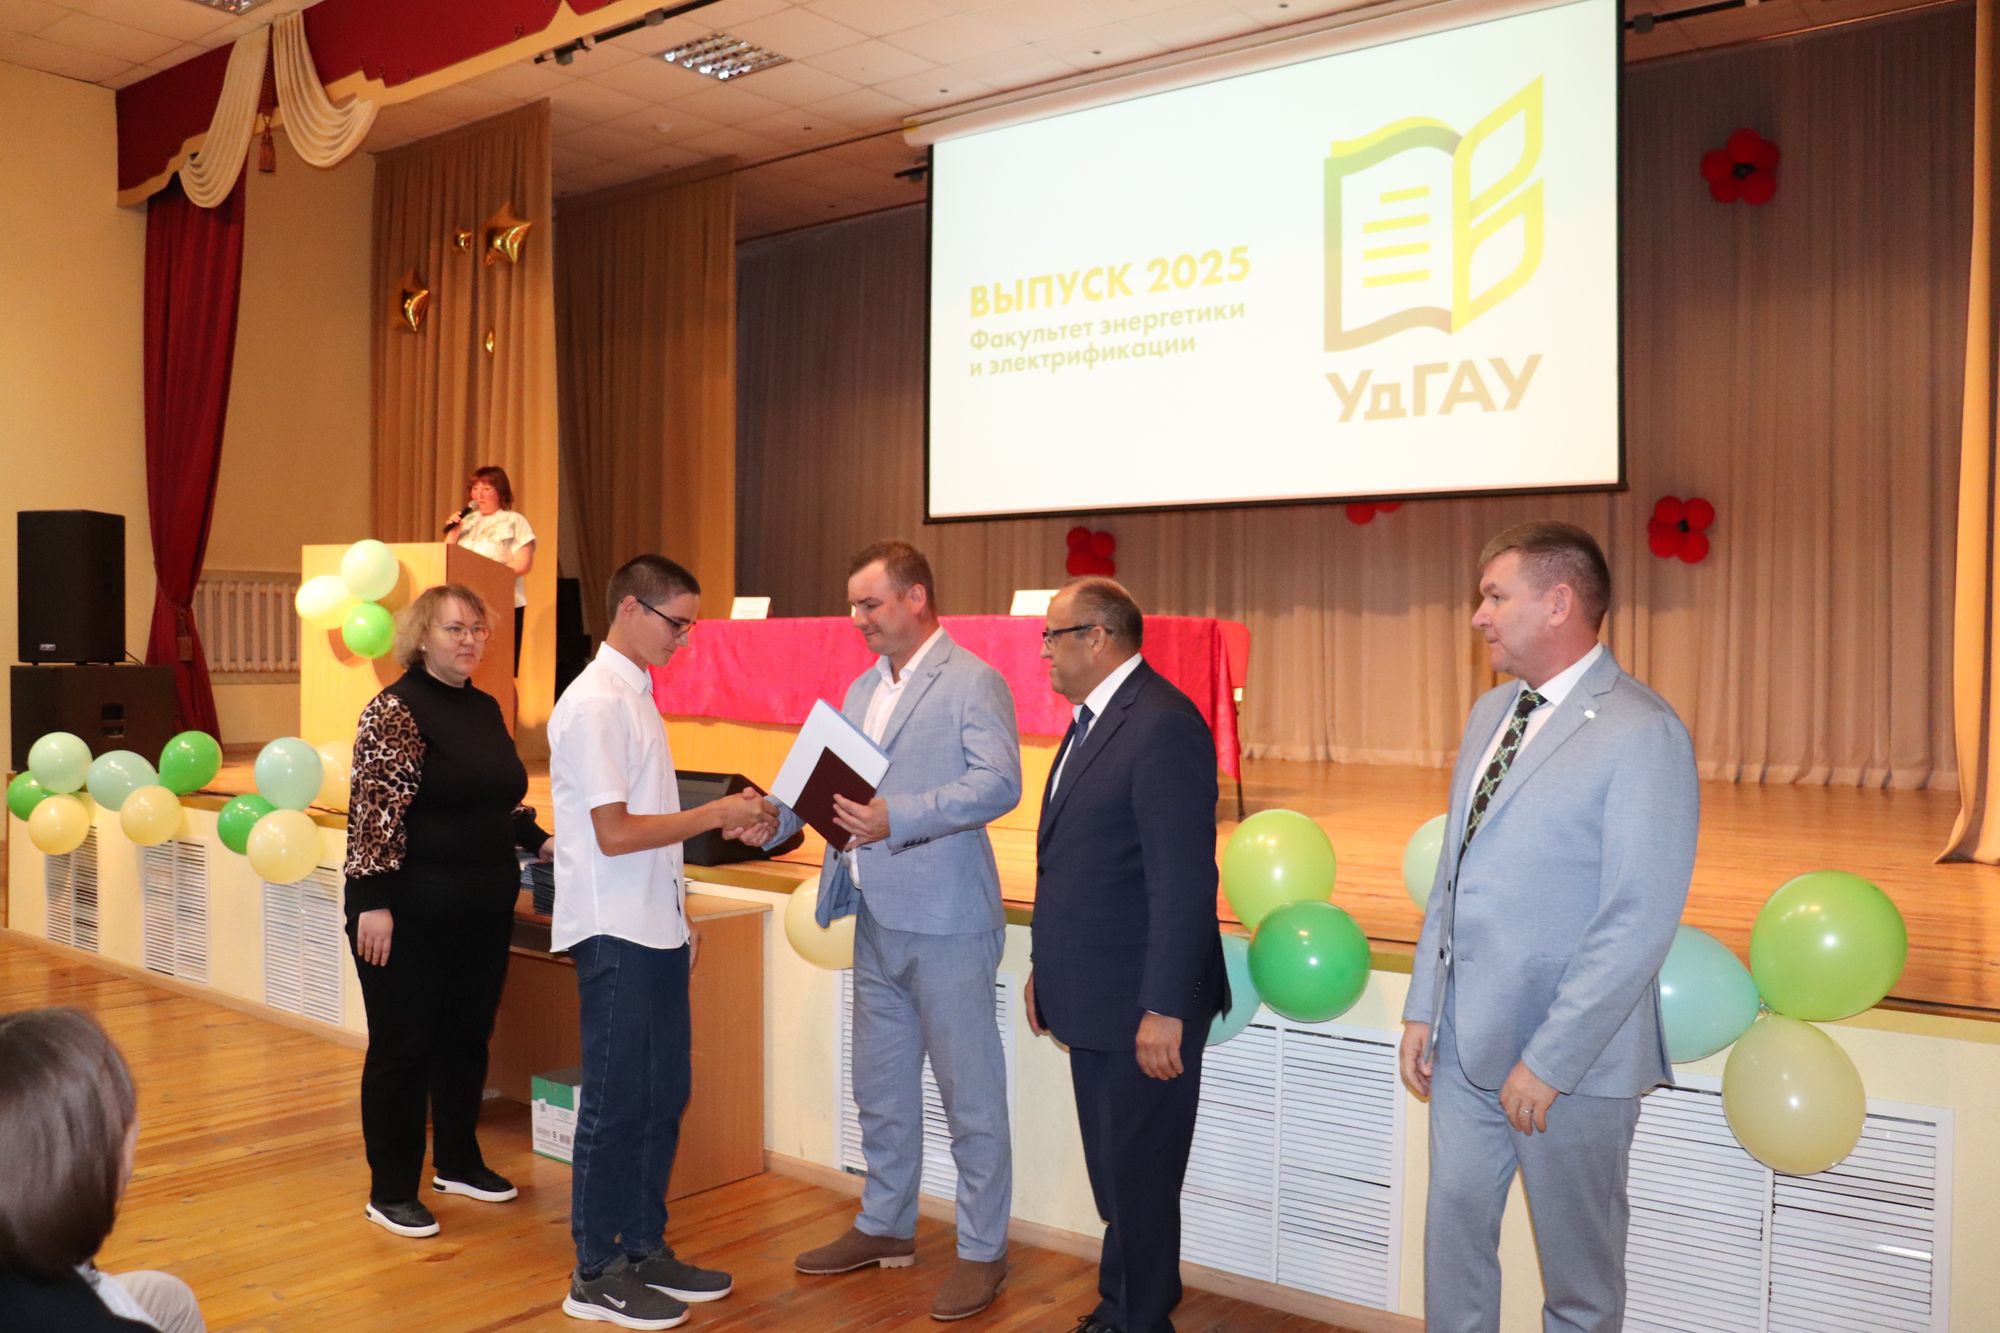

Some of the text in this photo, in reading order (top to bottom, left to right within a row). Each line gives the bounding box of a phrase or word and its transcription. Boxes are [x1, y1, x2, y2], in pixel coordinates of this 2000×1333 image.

[969, 245, 1250, 318] ВЫПУСК 2025
[969, 335, 1197, 377] и электрификации
[970, 302, 1246, 351] Факультет энергетики
[1325, 353, 1544, 424] УдГАУ
